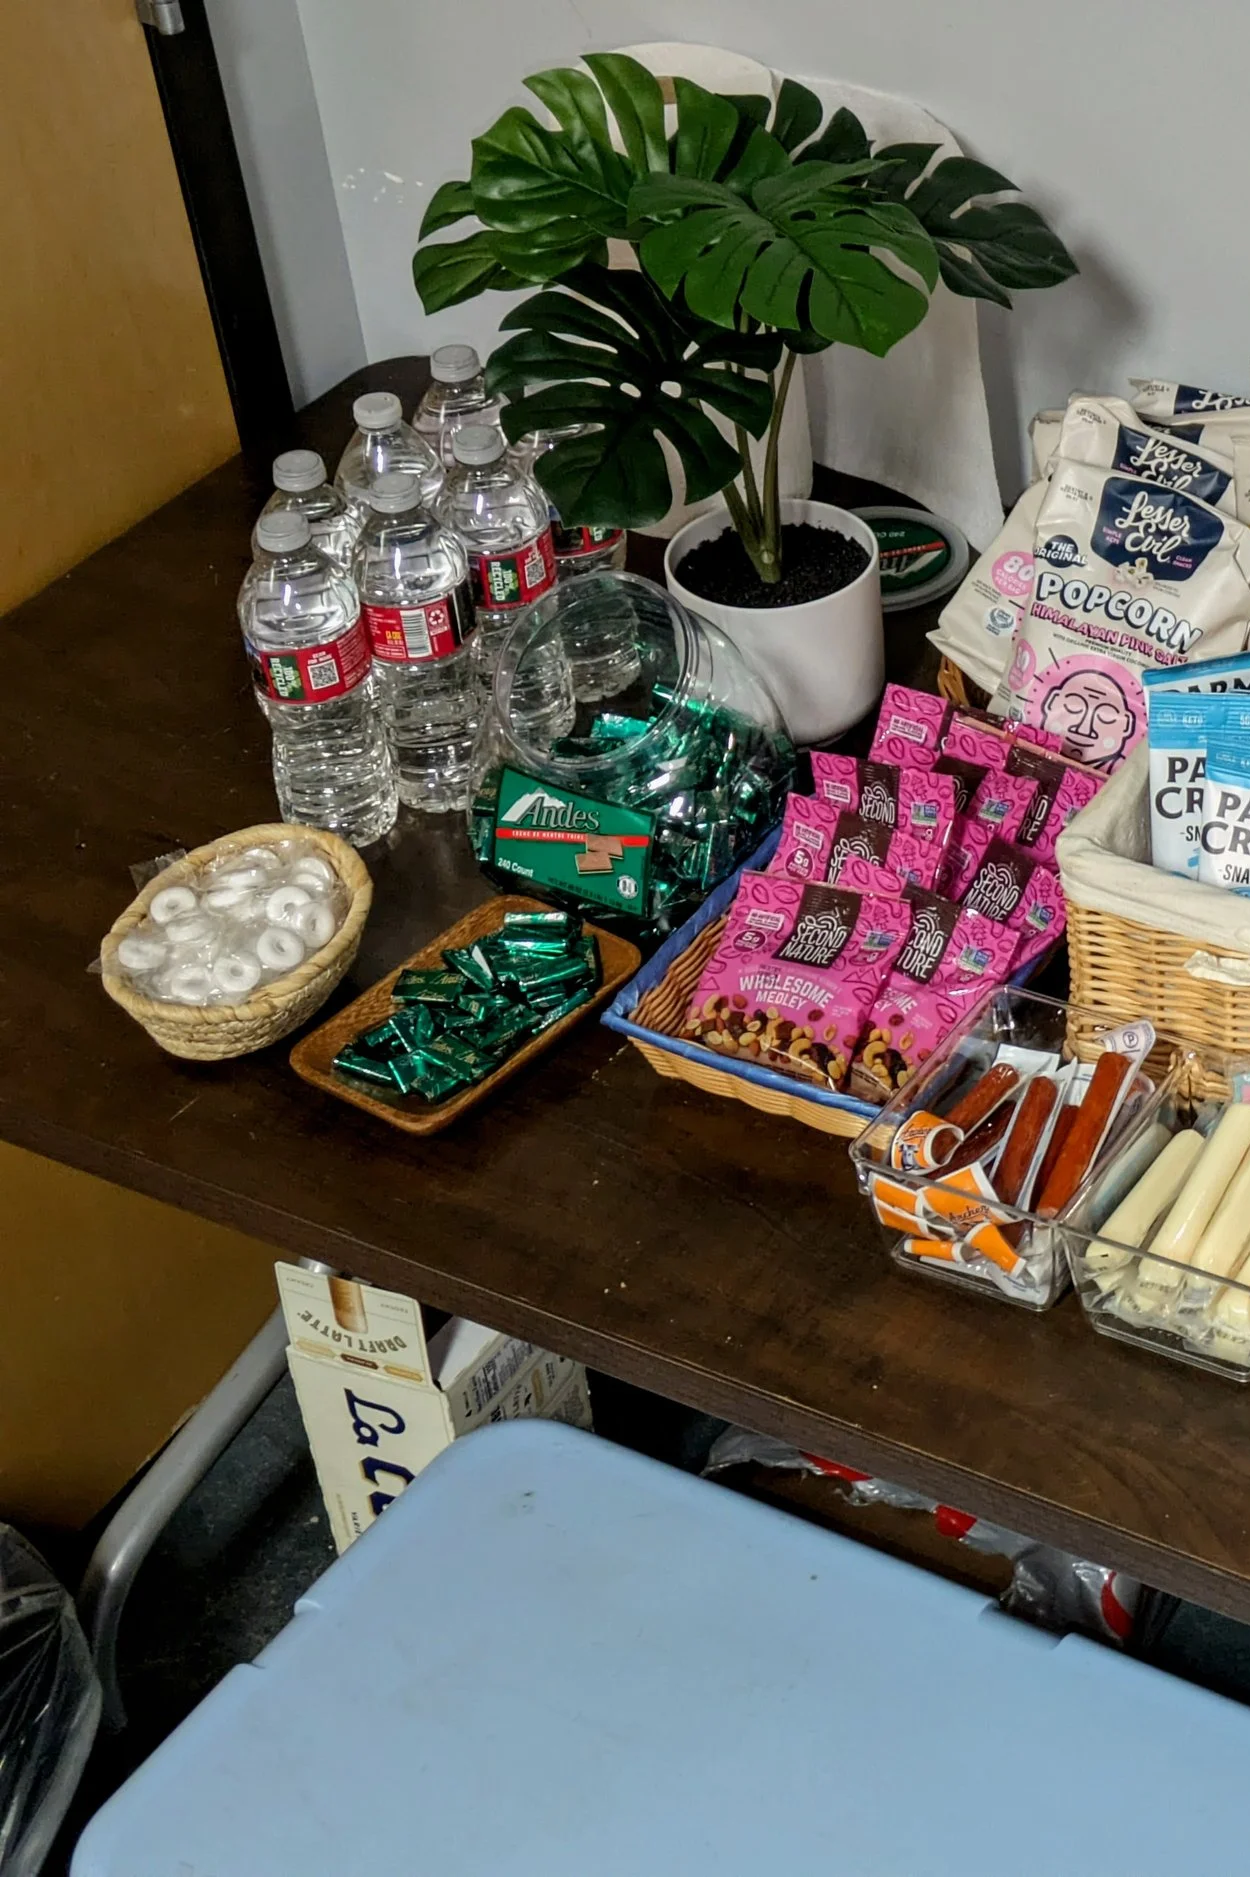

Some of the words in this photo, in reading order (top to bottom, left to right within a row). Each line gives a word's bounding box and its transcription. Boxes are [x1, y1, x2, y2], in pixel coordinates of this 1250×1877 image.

[1130, 437, 1202, 478] Lesser
[1115, 491, 1191, 537] Lesser
[1051, 540, 1074, 555] THE
[1125, 522, 1183, 563] Evil
[489, 561, 506, 601] RECYCLED
[1003, 555, 1034, 581] 80
[1036, 571, 1203, 654] POPCORN
[1030, 602, 1120, 647] HIMALAYAN
[1119, 633, 1155, 658] PINK
[1153, 647, 1189, 667] SALT
[269, 657, 289, 697] RECYCLED
[518, 796, 601, 830] Andes
[859, 793, 896, 828] SECOND
[497, 858, 512, 871] 240
[511, 862, 534, 878] Count
[793, 849, 809, 867] 5g
[973, 867, 1023, 912] SECOND
[741, 931, 761, 944] 5g
[779, 940, 837, 965] NATURE
[791, 922, 848, 950] SECOND
[739, 973, 834, 1009] WHOLESOME
[755, 990, 808, 1010] MEDLEY
[358, 1335, 408, 1354] DRAFT
